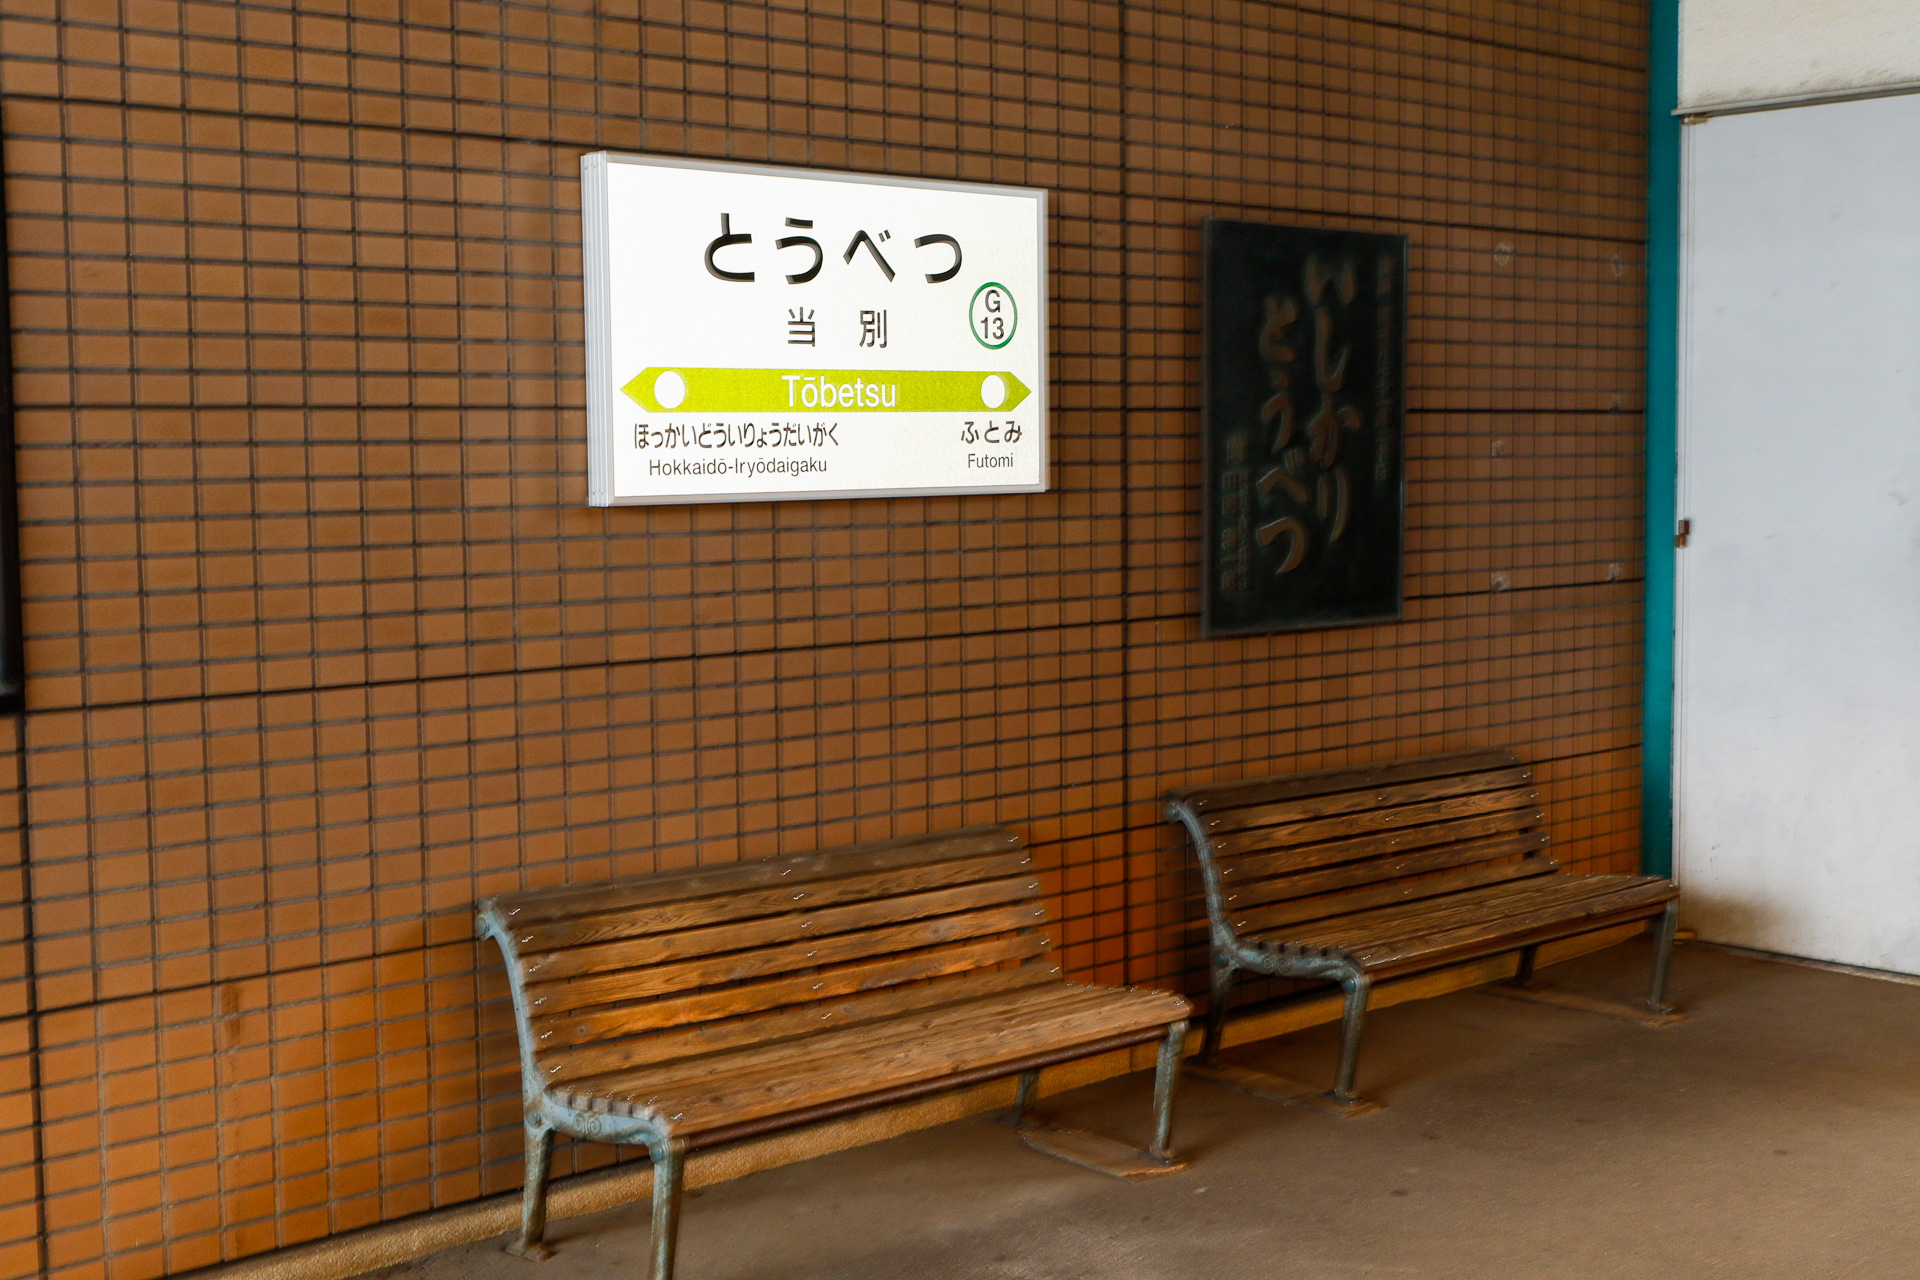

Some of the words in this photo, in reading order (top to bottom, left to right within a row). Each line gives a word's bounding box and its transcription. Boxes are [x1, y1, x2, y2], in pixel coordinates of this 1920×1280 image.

[704, 212, 963, 285] とうべつ
[984, 289, 1001, 313] G
[787, 306, 888, 349] 当別
[980, 316, 1005, 340] 13
[781, 374, 896, 408] Tōbetsu
[634, 422, 839, 449] ほっかいどういりょうだいがく
[961, 420, 1023, 445] ふとみ
[649, 457, 828, 478] Hokkaidō-Iryōdaigaku
[968, 453, 1014, 469] Futomi
